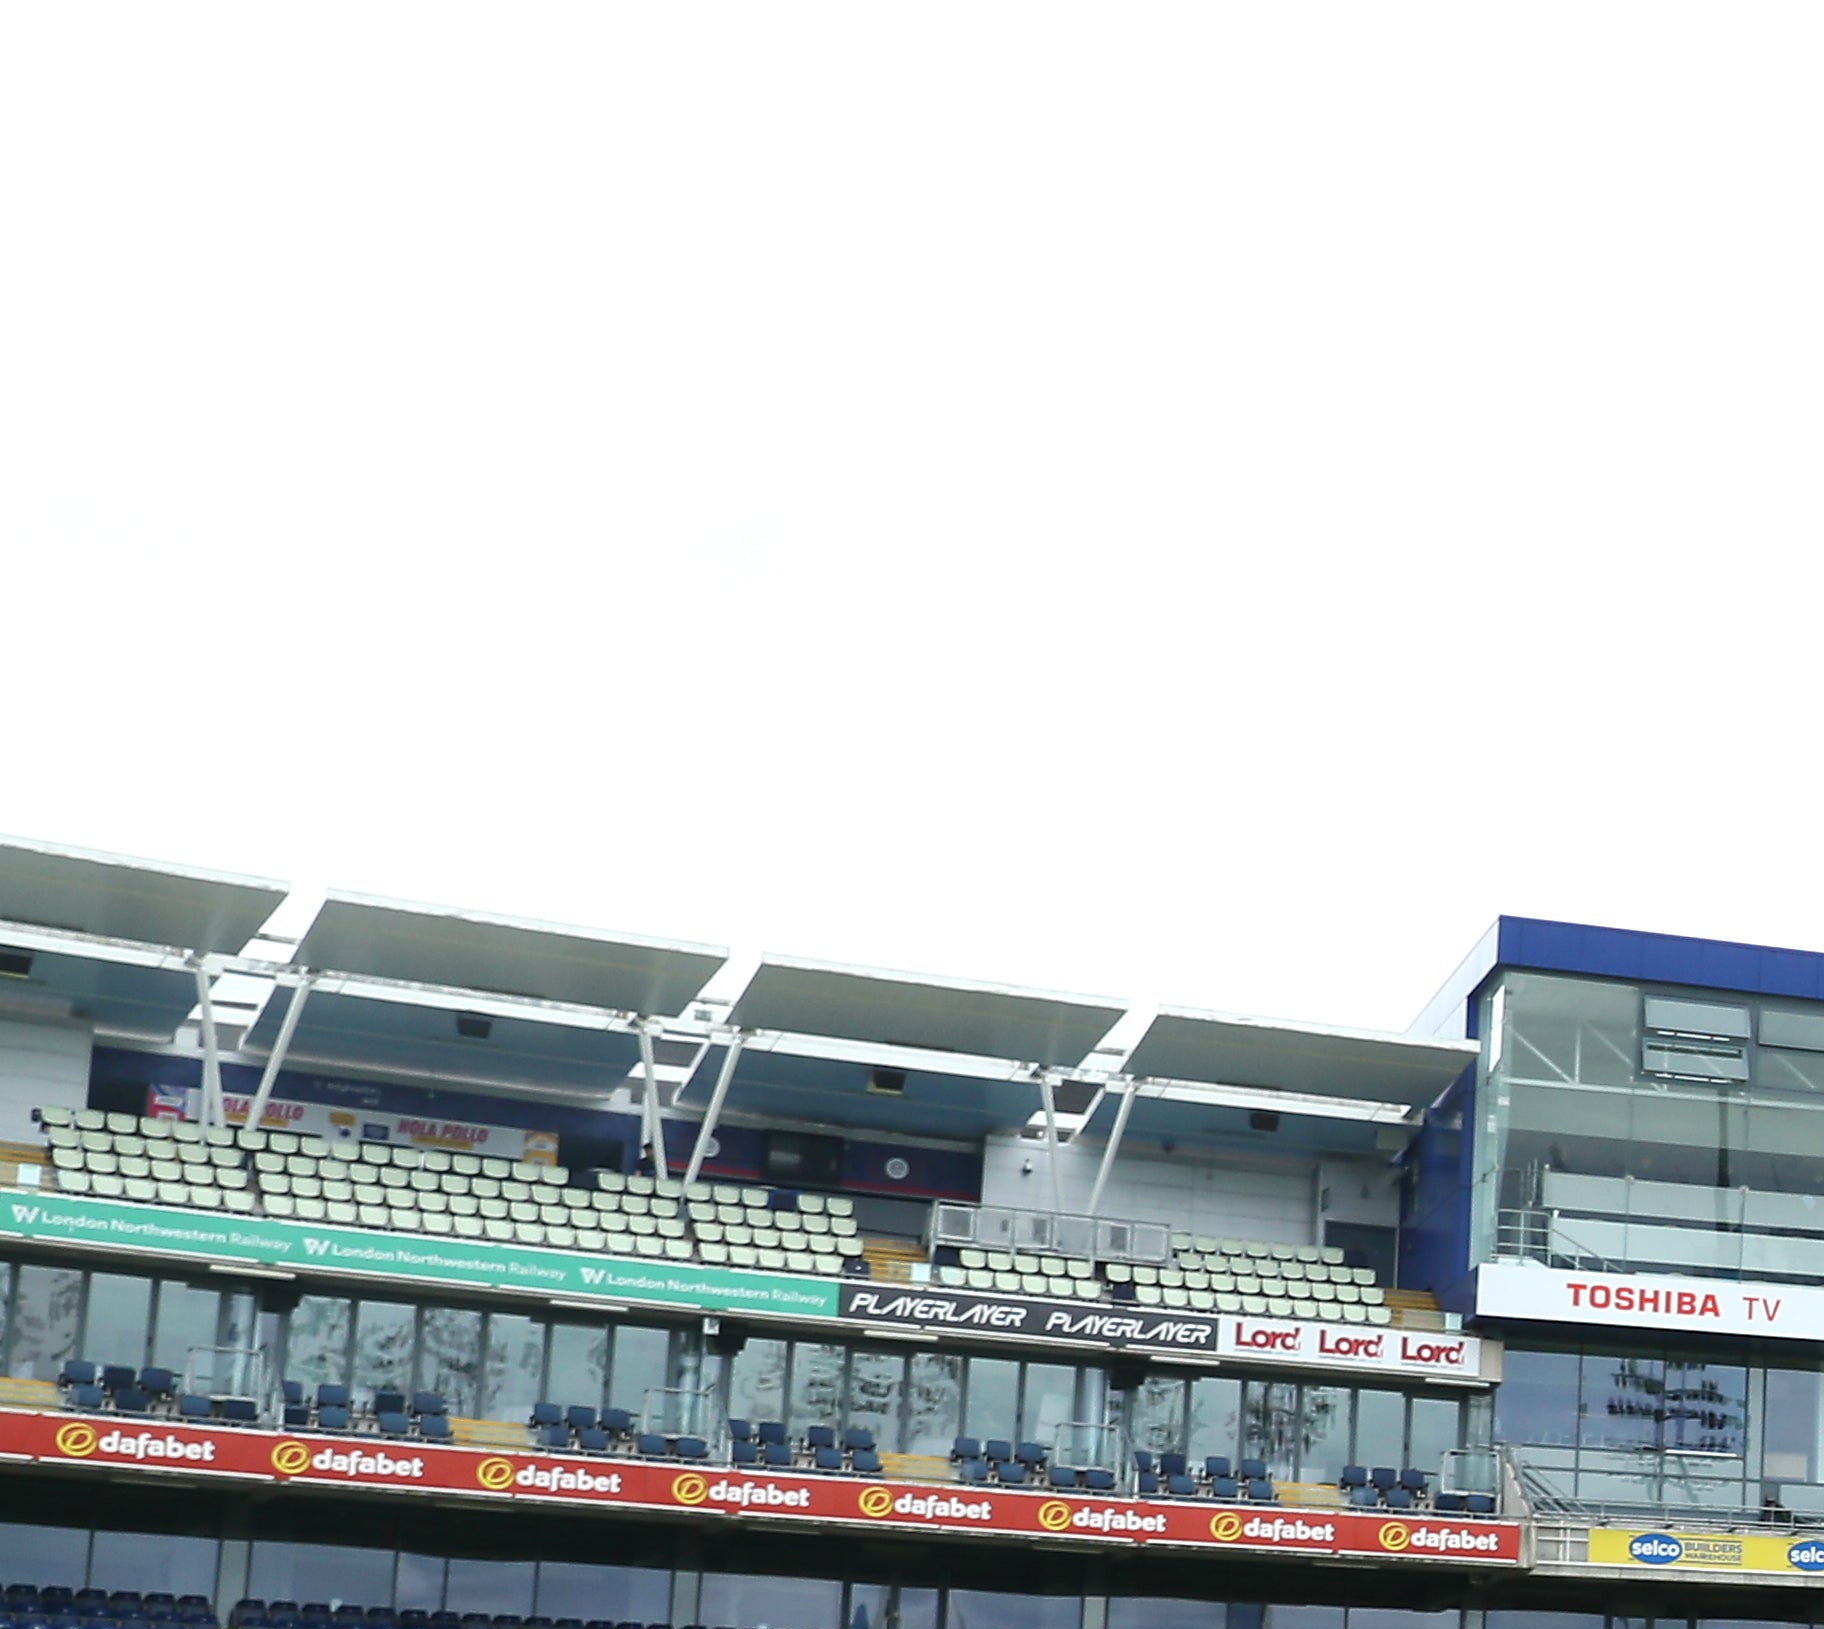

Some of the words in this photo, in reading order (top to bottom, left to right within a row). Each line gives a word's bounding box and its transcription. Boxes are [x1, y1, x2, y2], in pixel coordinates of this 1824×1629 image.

[41, 1211, 108, 1232] London
[111, 1218, 226, 1243] Northwestern
[230, 1233, 292, 1251] Railway
[331, 1243, 395, 1261] London
[398, 1249, 505, 1272] Northwestern
[508, 1261, 567, 1280] Railway
[607, 1272, 664, 1287] London
[667, 1276, 768, 1299] Northwestern
[772, 1289, 826, 1306] Railway
[1567, 1283, 1720, 1317] TOSHIBA
[1743, 1297, 1781, 1321] TV
[849, 1293, 1027, 1327] PLAYERLAYER
[1046, 1312, 1211, 1343] PLAYERLAYER
[99, 1431, 215, 1462] dafabet
[312, 1449, 424, 1478] dafabet
[515, 1465, 621, 1493] dafabet
[709, 1481, 810, 1507] dafabet
[894, 1495, 992, 1521] dafabet
[1072, 1510, 1166, 1532] dafabet
[1243, 1517, 1335, 1541] dafabet
[1411, 1527, 1498, 1550] dafabet
[1632, 1541, 1679, 1557] selco
[1684, 1542, 1743, 1554] BUILDERS
[1684, 1552, 1742, 1563] WAREHOUSE
